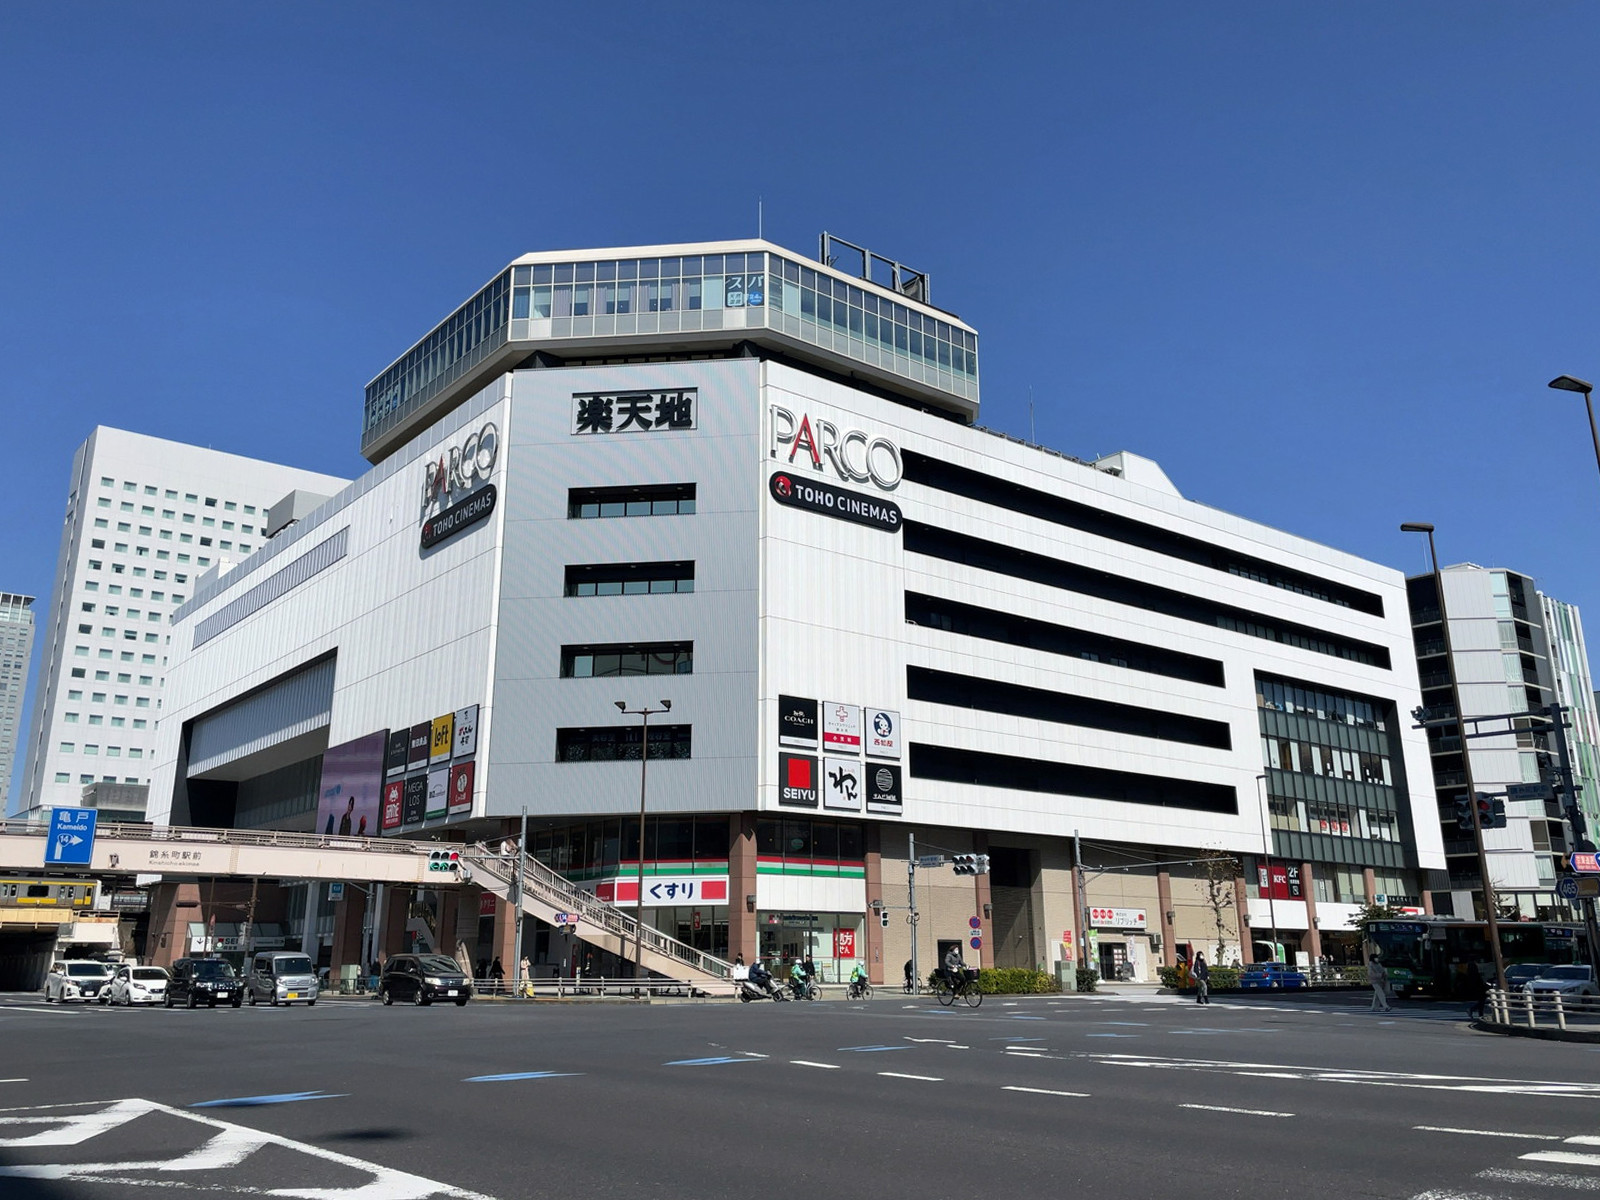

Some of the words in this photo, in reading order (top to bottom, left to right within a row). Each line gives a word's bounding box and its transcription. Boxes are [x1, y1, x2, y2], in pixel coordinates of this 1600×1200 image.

[728, 275, 764, 289] スパ
[576, 392, 693, 433] 楽天地
[769, 404, 904, 488] PARCO
[422, 422, 498, 508] PARCO
[795, 484, 834, 507] TOHO
[837, 496, 897, 524] CINEMAS
[432, 516, 453, 537] TOHO
[455, 493, 491, 523] CINEMAS
[784, 715, 813, 724] COACH
[408, 781, 423, 793] MEGA
[783, 787, 816, 801] SEIYU
[59, 811, 89, 823] 亀戸
[57, 823, 87, 831] Kameido
[60, 835, 69, 843] 14
[149, 849, 202, 861] 錦糸町駅前
[1289, 867, 1298, 878] 2F
[1273, 875, 1286, 884] KFC
[650, 882, 693, 899] くすり
[1562, 883, 1576, 895] 465
